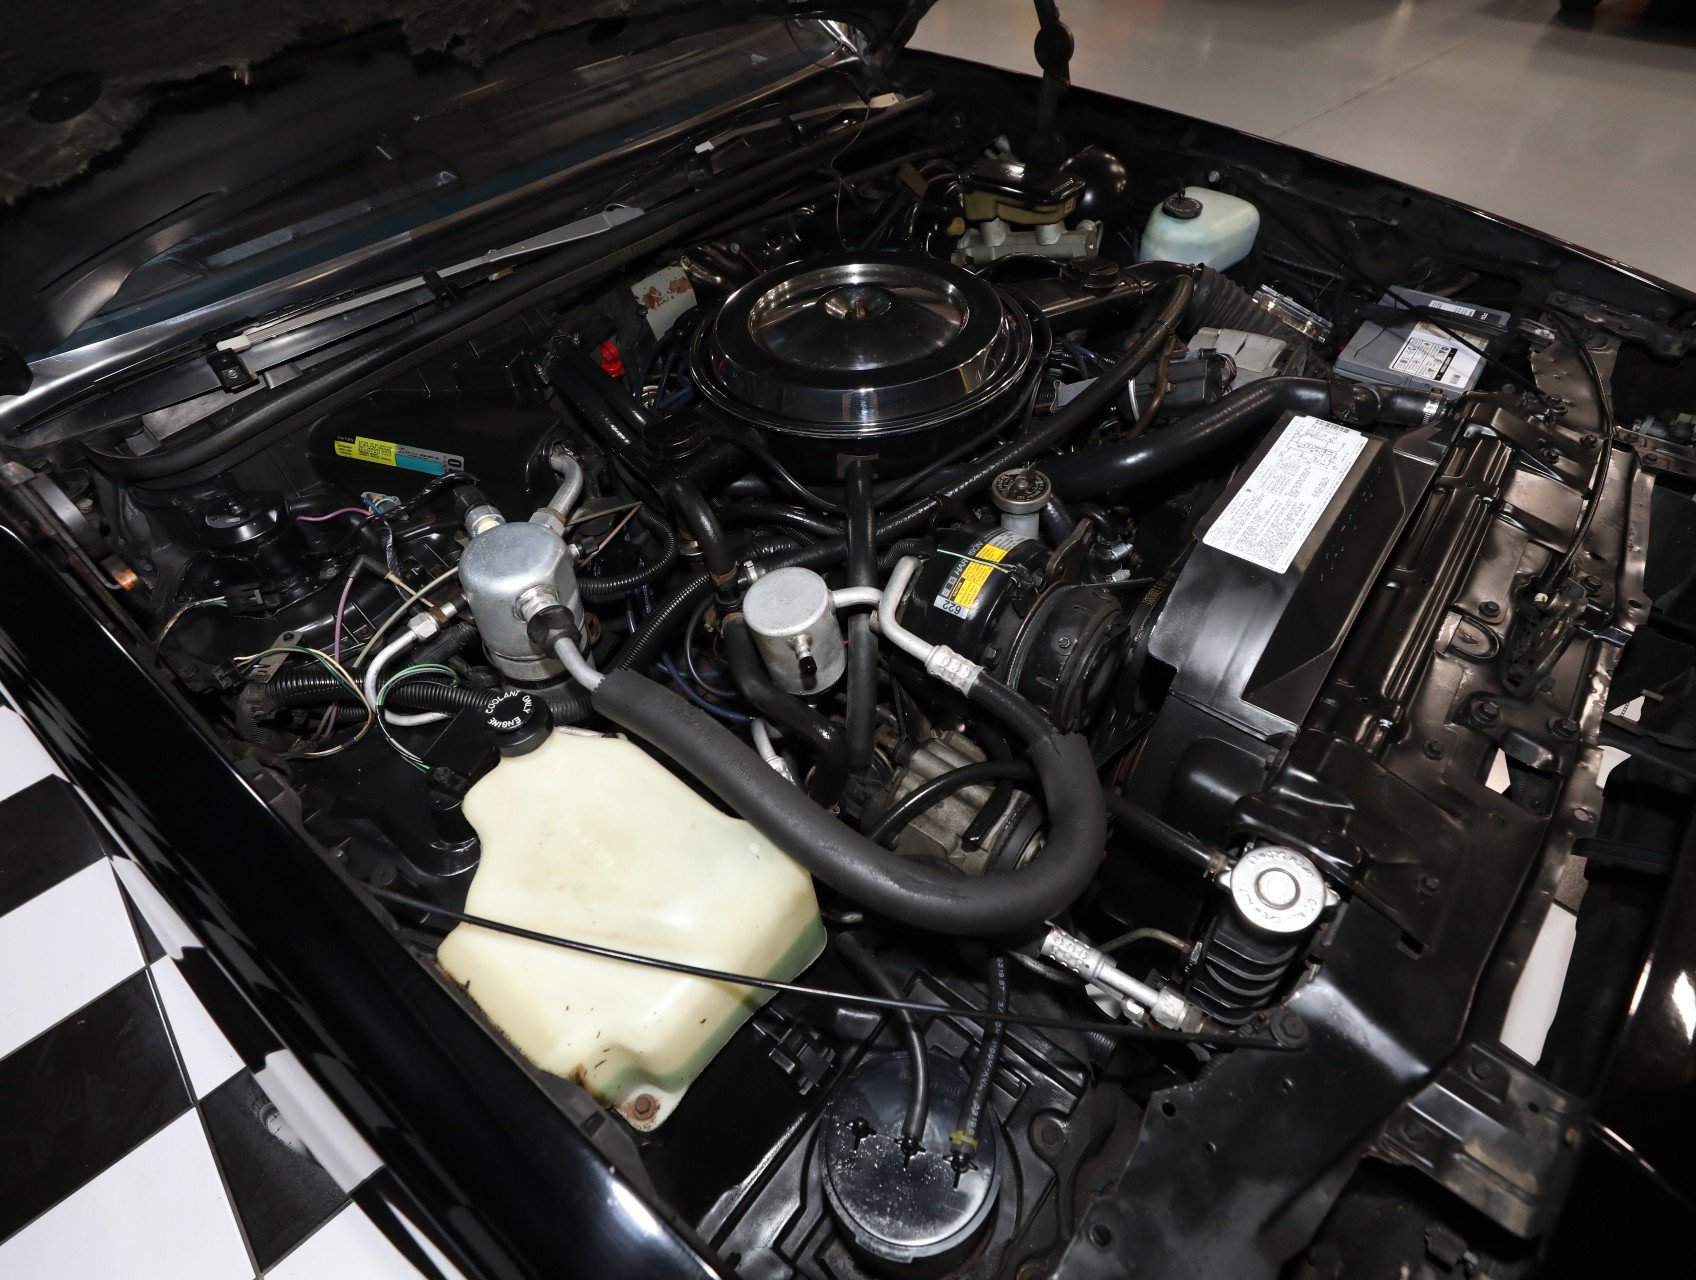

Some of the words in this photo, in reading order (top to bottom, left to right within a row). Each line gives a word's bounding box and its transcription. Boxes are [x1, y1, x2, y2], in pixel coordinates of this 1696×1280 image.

[954, 541, 984, 576] HARISON
[942, 600, 962, 615] 622
[485, 690, 522, 714] COOLANT
[522, 695, 533, 714] ONLY
[487, 717, 522, 728] ENGINE
